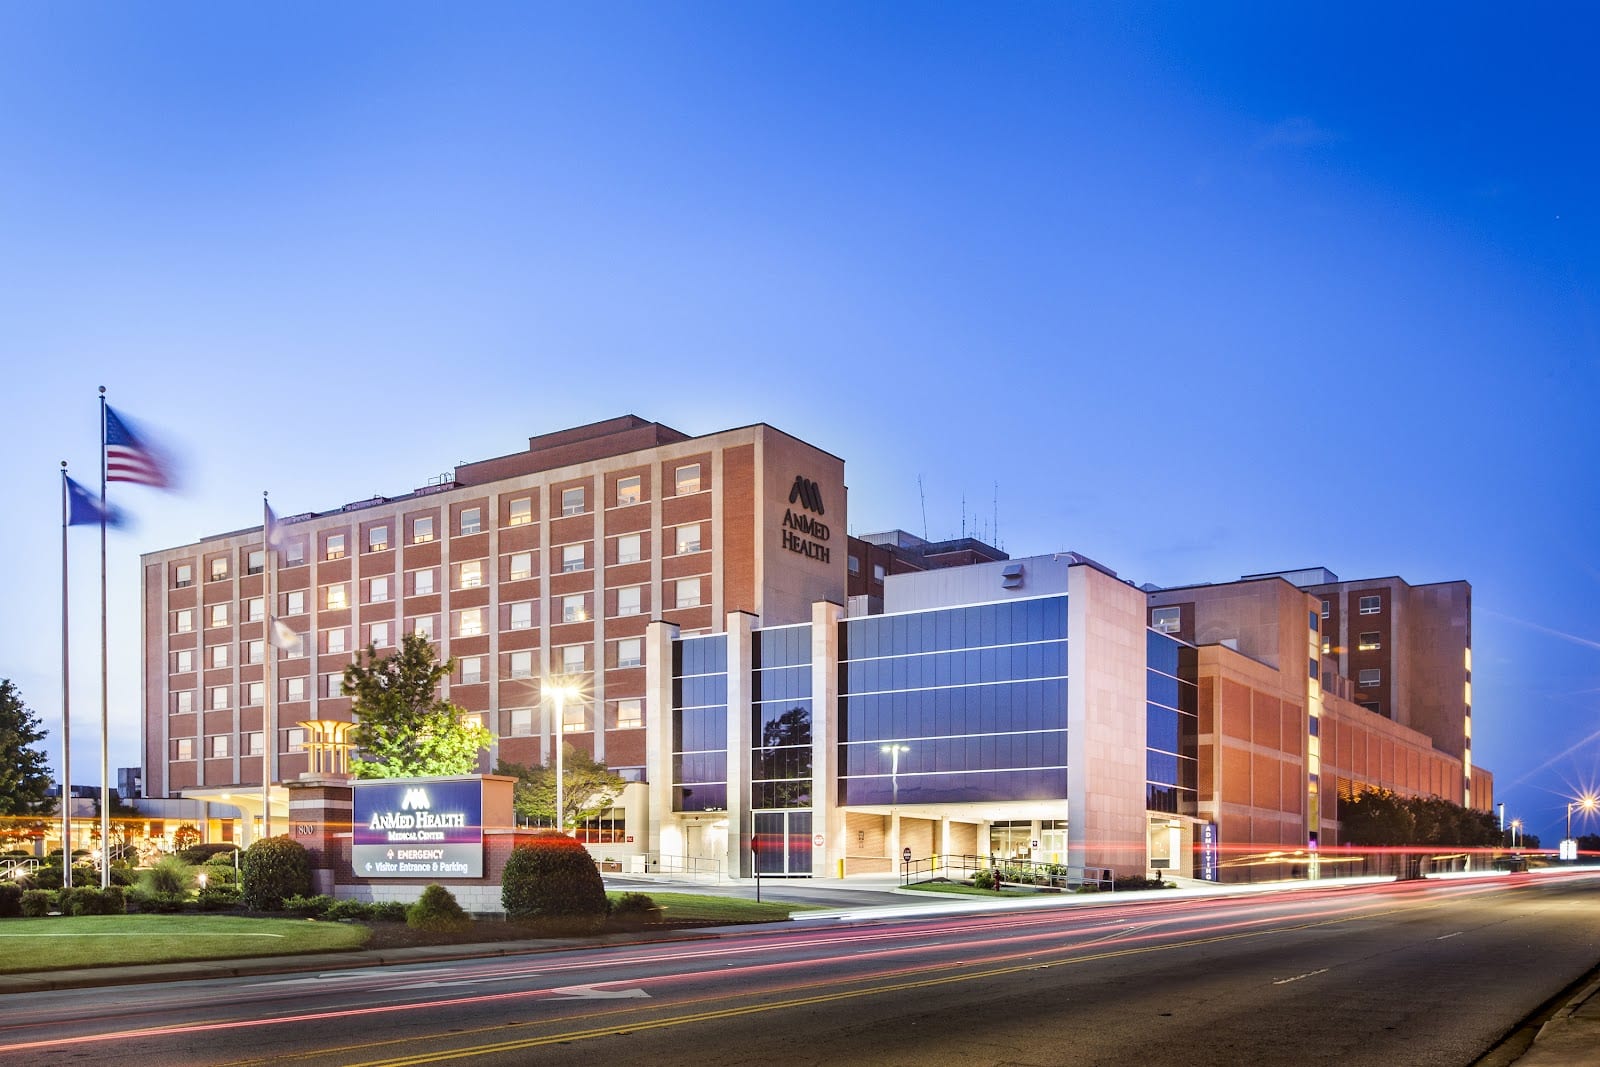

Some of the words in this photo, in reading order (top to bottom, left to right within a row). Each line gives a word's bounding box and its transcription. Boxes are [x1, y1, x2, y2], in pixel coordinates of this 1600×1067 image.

[782, 529, 831, 564] HEALTH
[416, 811, 465, 829] HEALTH
[298, 824, 314, 835] 800
[388, 831, 417, 841] MEDICAL
[418, 830, 445, 840] CENTER
[397, 849, 444, 860] EMERGENCY
[375, 862, 398, 872] Visitor
[399, 862, 431, 872] Entrance
[432, 862, 438, 872] &
[440, 861, 468, 874] Parking
